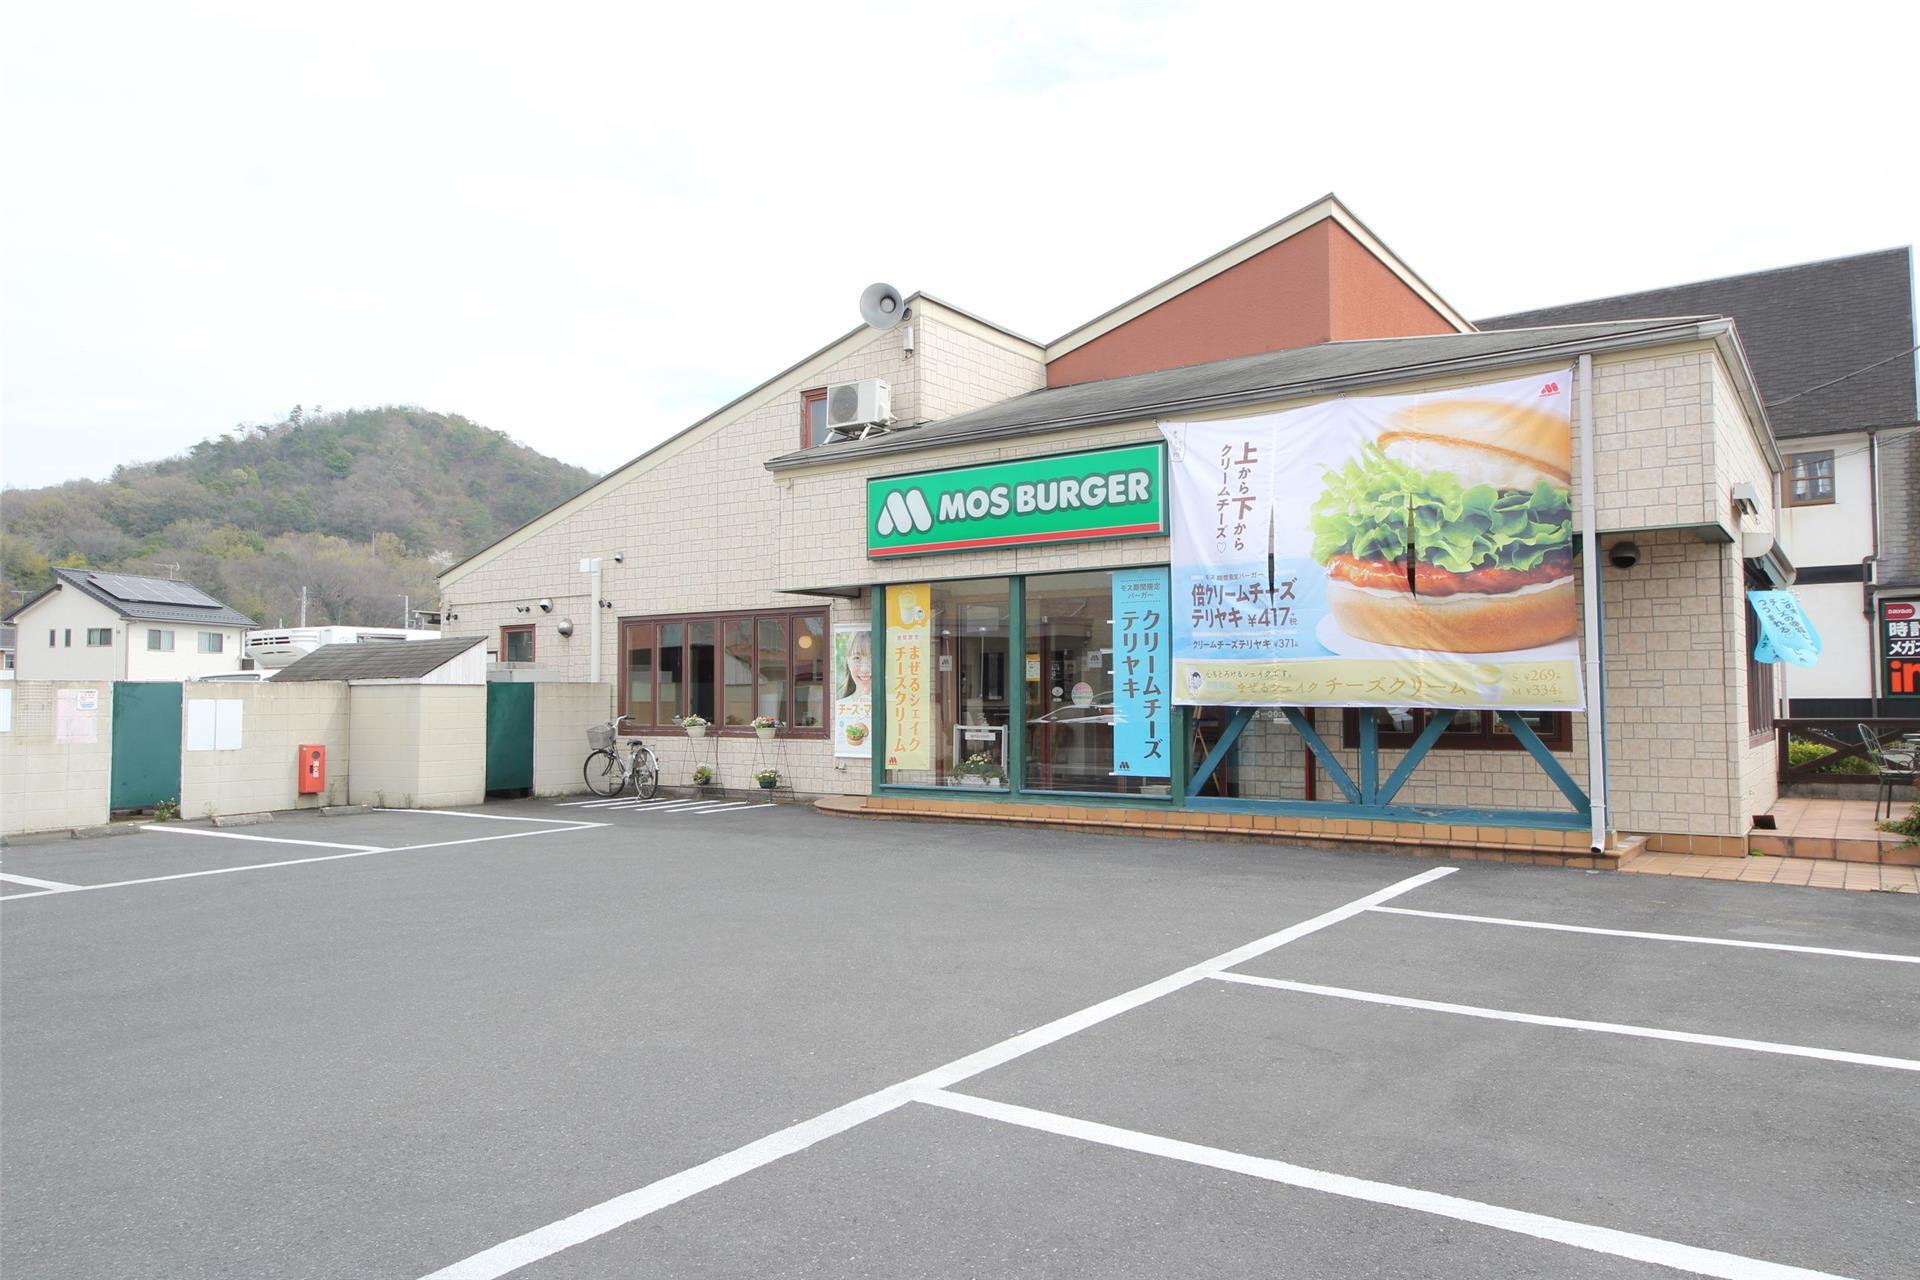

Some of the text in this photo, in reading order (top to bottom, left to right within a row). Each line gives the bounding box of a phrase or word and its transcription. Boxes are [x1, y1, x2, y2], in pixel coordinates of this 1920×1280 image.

[938, 486, 1010, 521] MOS
[1016, 471, 1150, 513] BURGER
[1232, 441, 1258, 551] 上から下から
[1120, 611, 1140, 698] テリヤキ
[1191, 607, 1243, 629] テリヤキ
[1143, 609, 1163, 759] クリームチーズ
